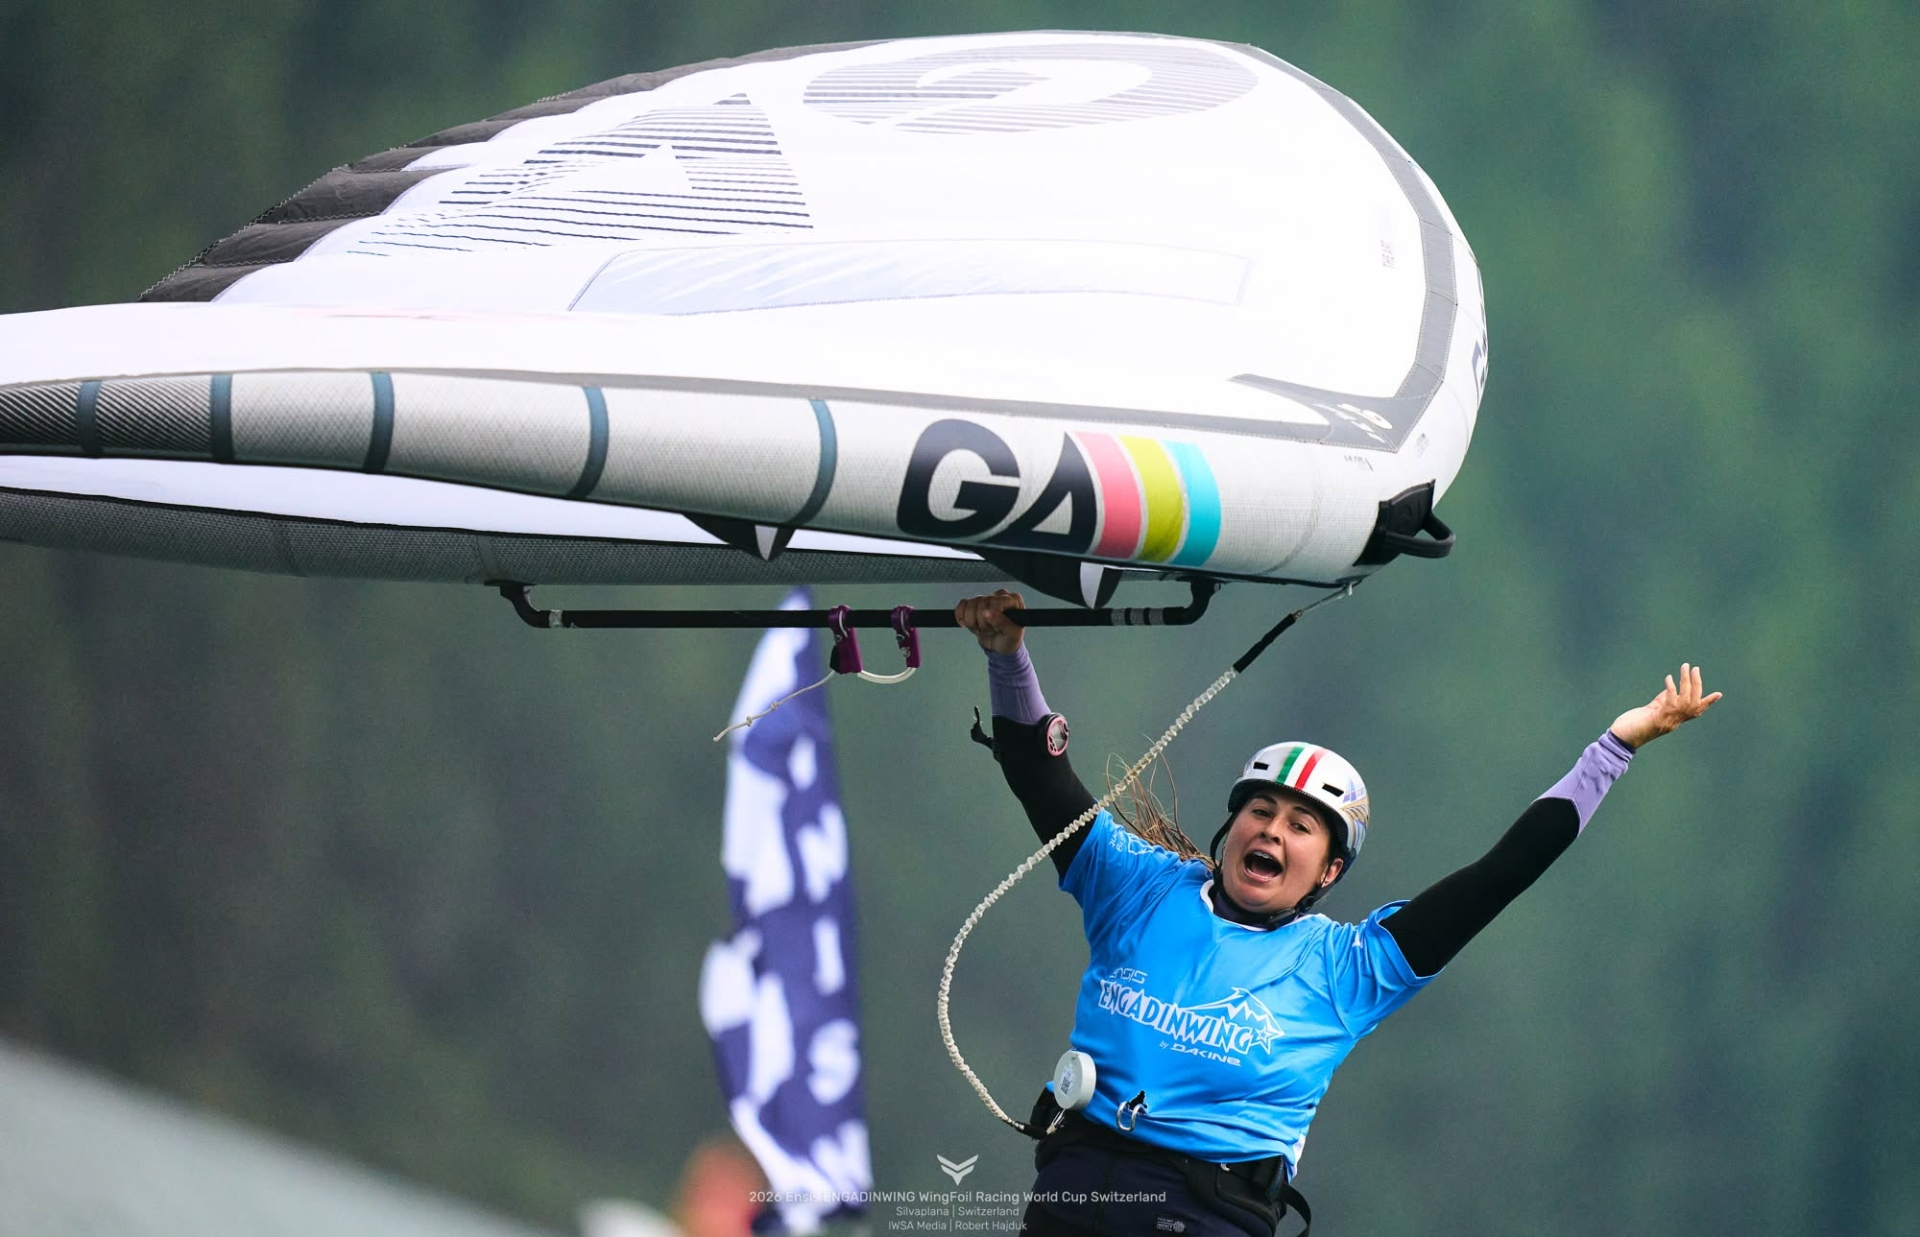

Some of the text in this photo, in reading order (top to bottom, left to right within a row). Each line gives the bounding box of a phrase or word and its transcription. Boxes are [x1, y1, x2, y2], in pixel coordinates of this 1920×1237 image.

[895, 418, 1098, 555] GA
[1098, 979, 1252, 1055] ENGADINWING
[1159, 1040, 1242, 1067] by DAKINE
